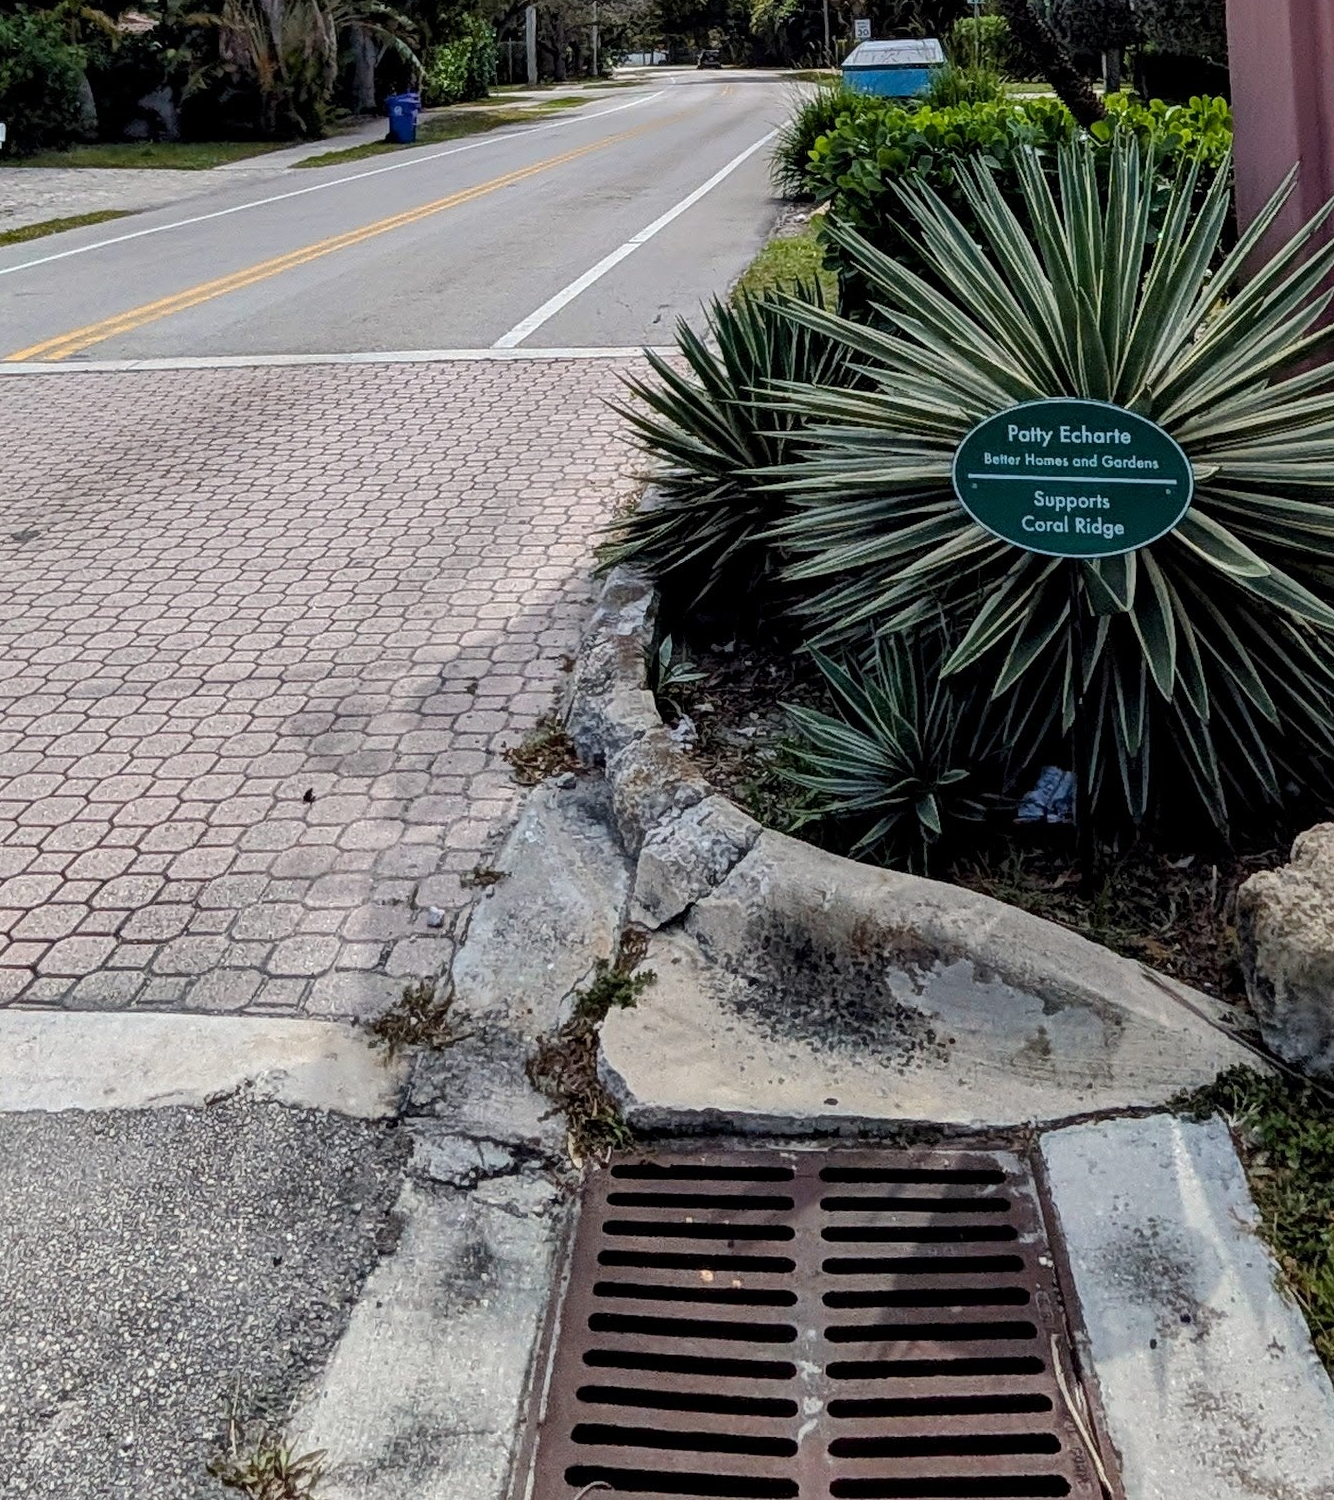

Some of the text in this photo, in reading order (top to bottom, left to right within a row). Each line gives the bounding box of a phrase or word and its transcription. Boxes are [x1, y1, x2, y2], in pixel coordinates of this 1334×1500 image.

[1007, 424, 1131, 447] Patty Echarte
[984, 452, 1159, 469] Better Homes and Gardens
[1033, 490, 1110, 512] Supports
[1021, 515, 1125, 540] Coral Ridge
